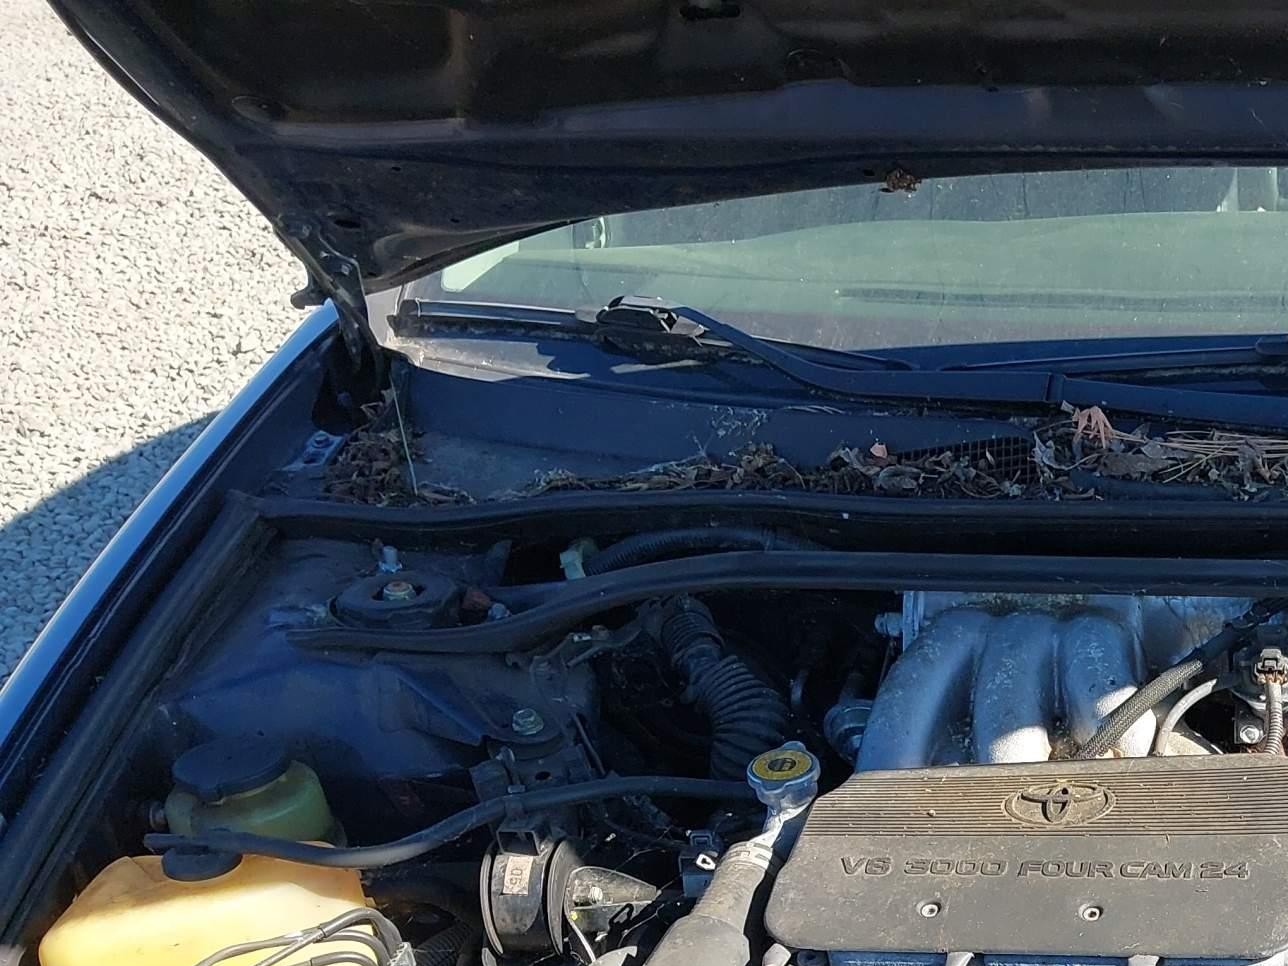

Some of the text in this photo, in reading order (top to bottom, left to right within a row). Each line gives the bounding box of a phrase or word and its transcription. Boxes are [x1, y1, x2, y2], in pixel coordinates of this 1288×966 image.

[841, 857, 1249, 880] V6 3000 FOUR CAM 24
